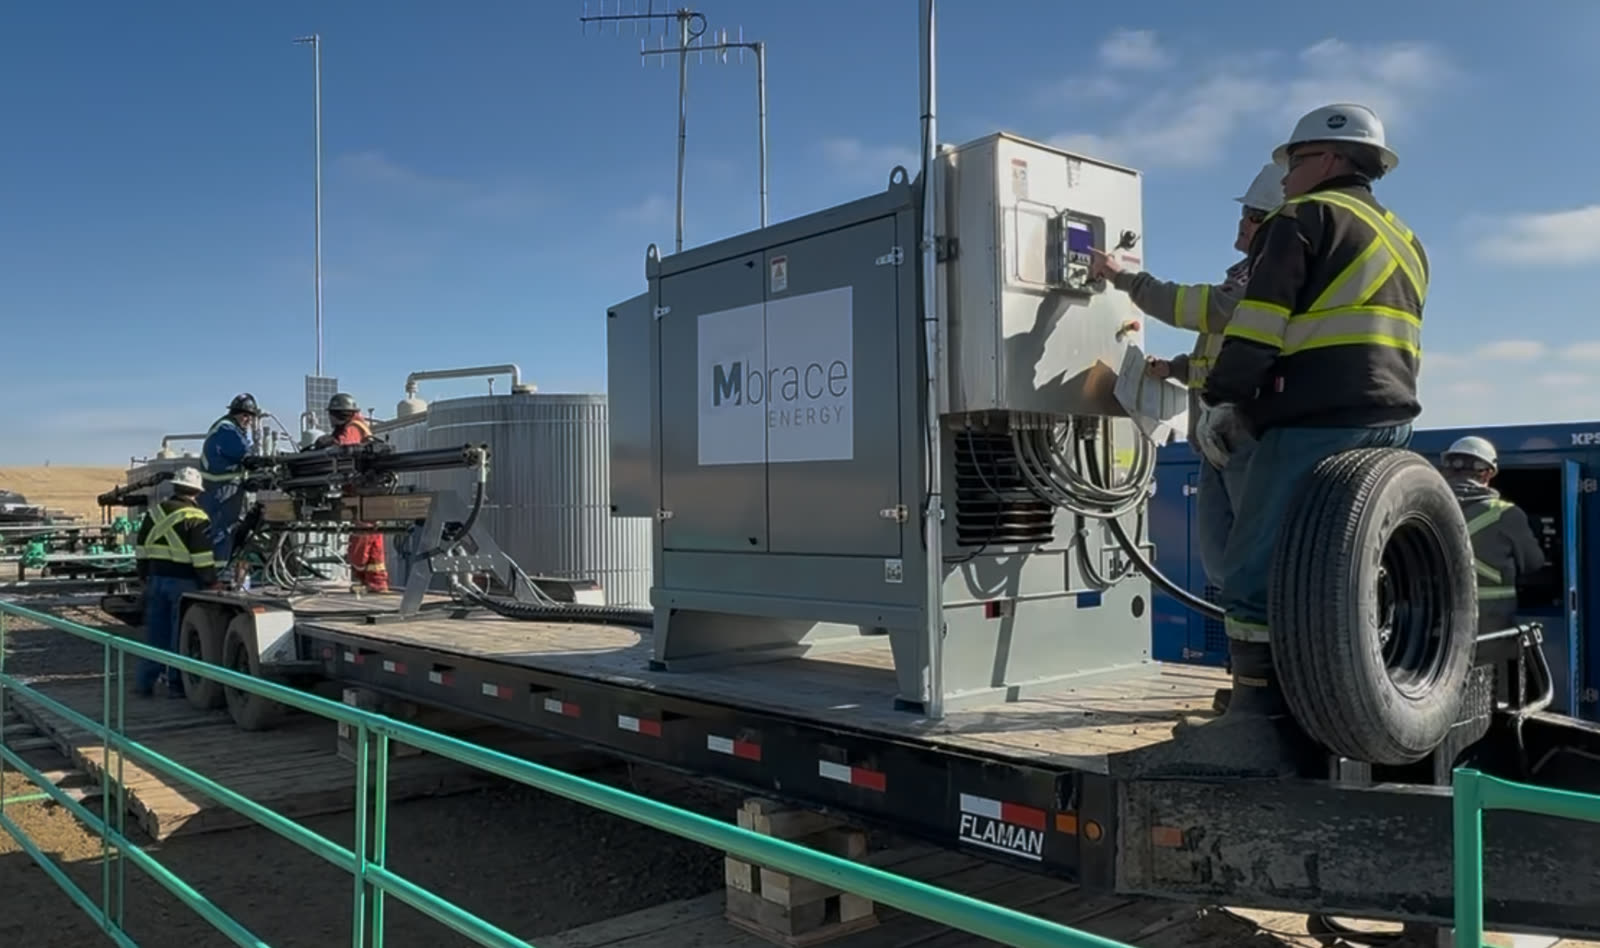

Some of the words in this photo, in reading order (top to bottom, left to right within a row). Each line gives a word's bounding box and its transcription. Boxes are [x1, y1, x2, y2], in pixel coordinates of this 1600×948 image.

[713, 360, 848, 407] Mbrace
[768, 406, 844, 428] ENERGY
[959, 814, 1044, 855] FLAMAN
